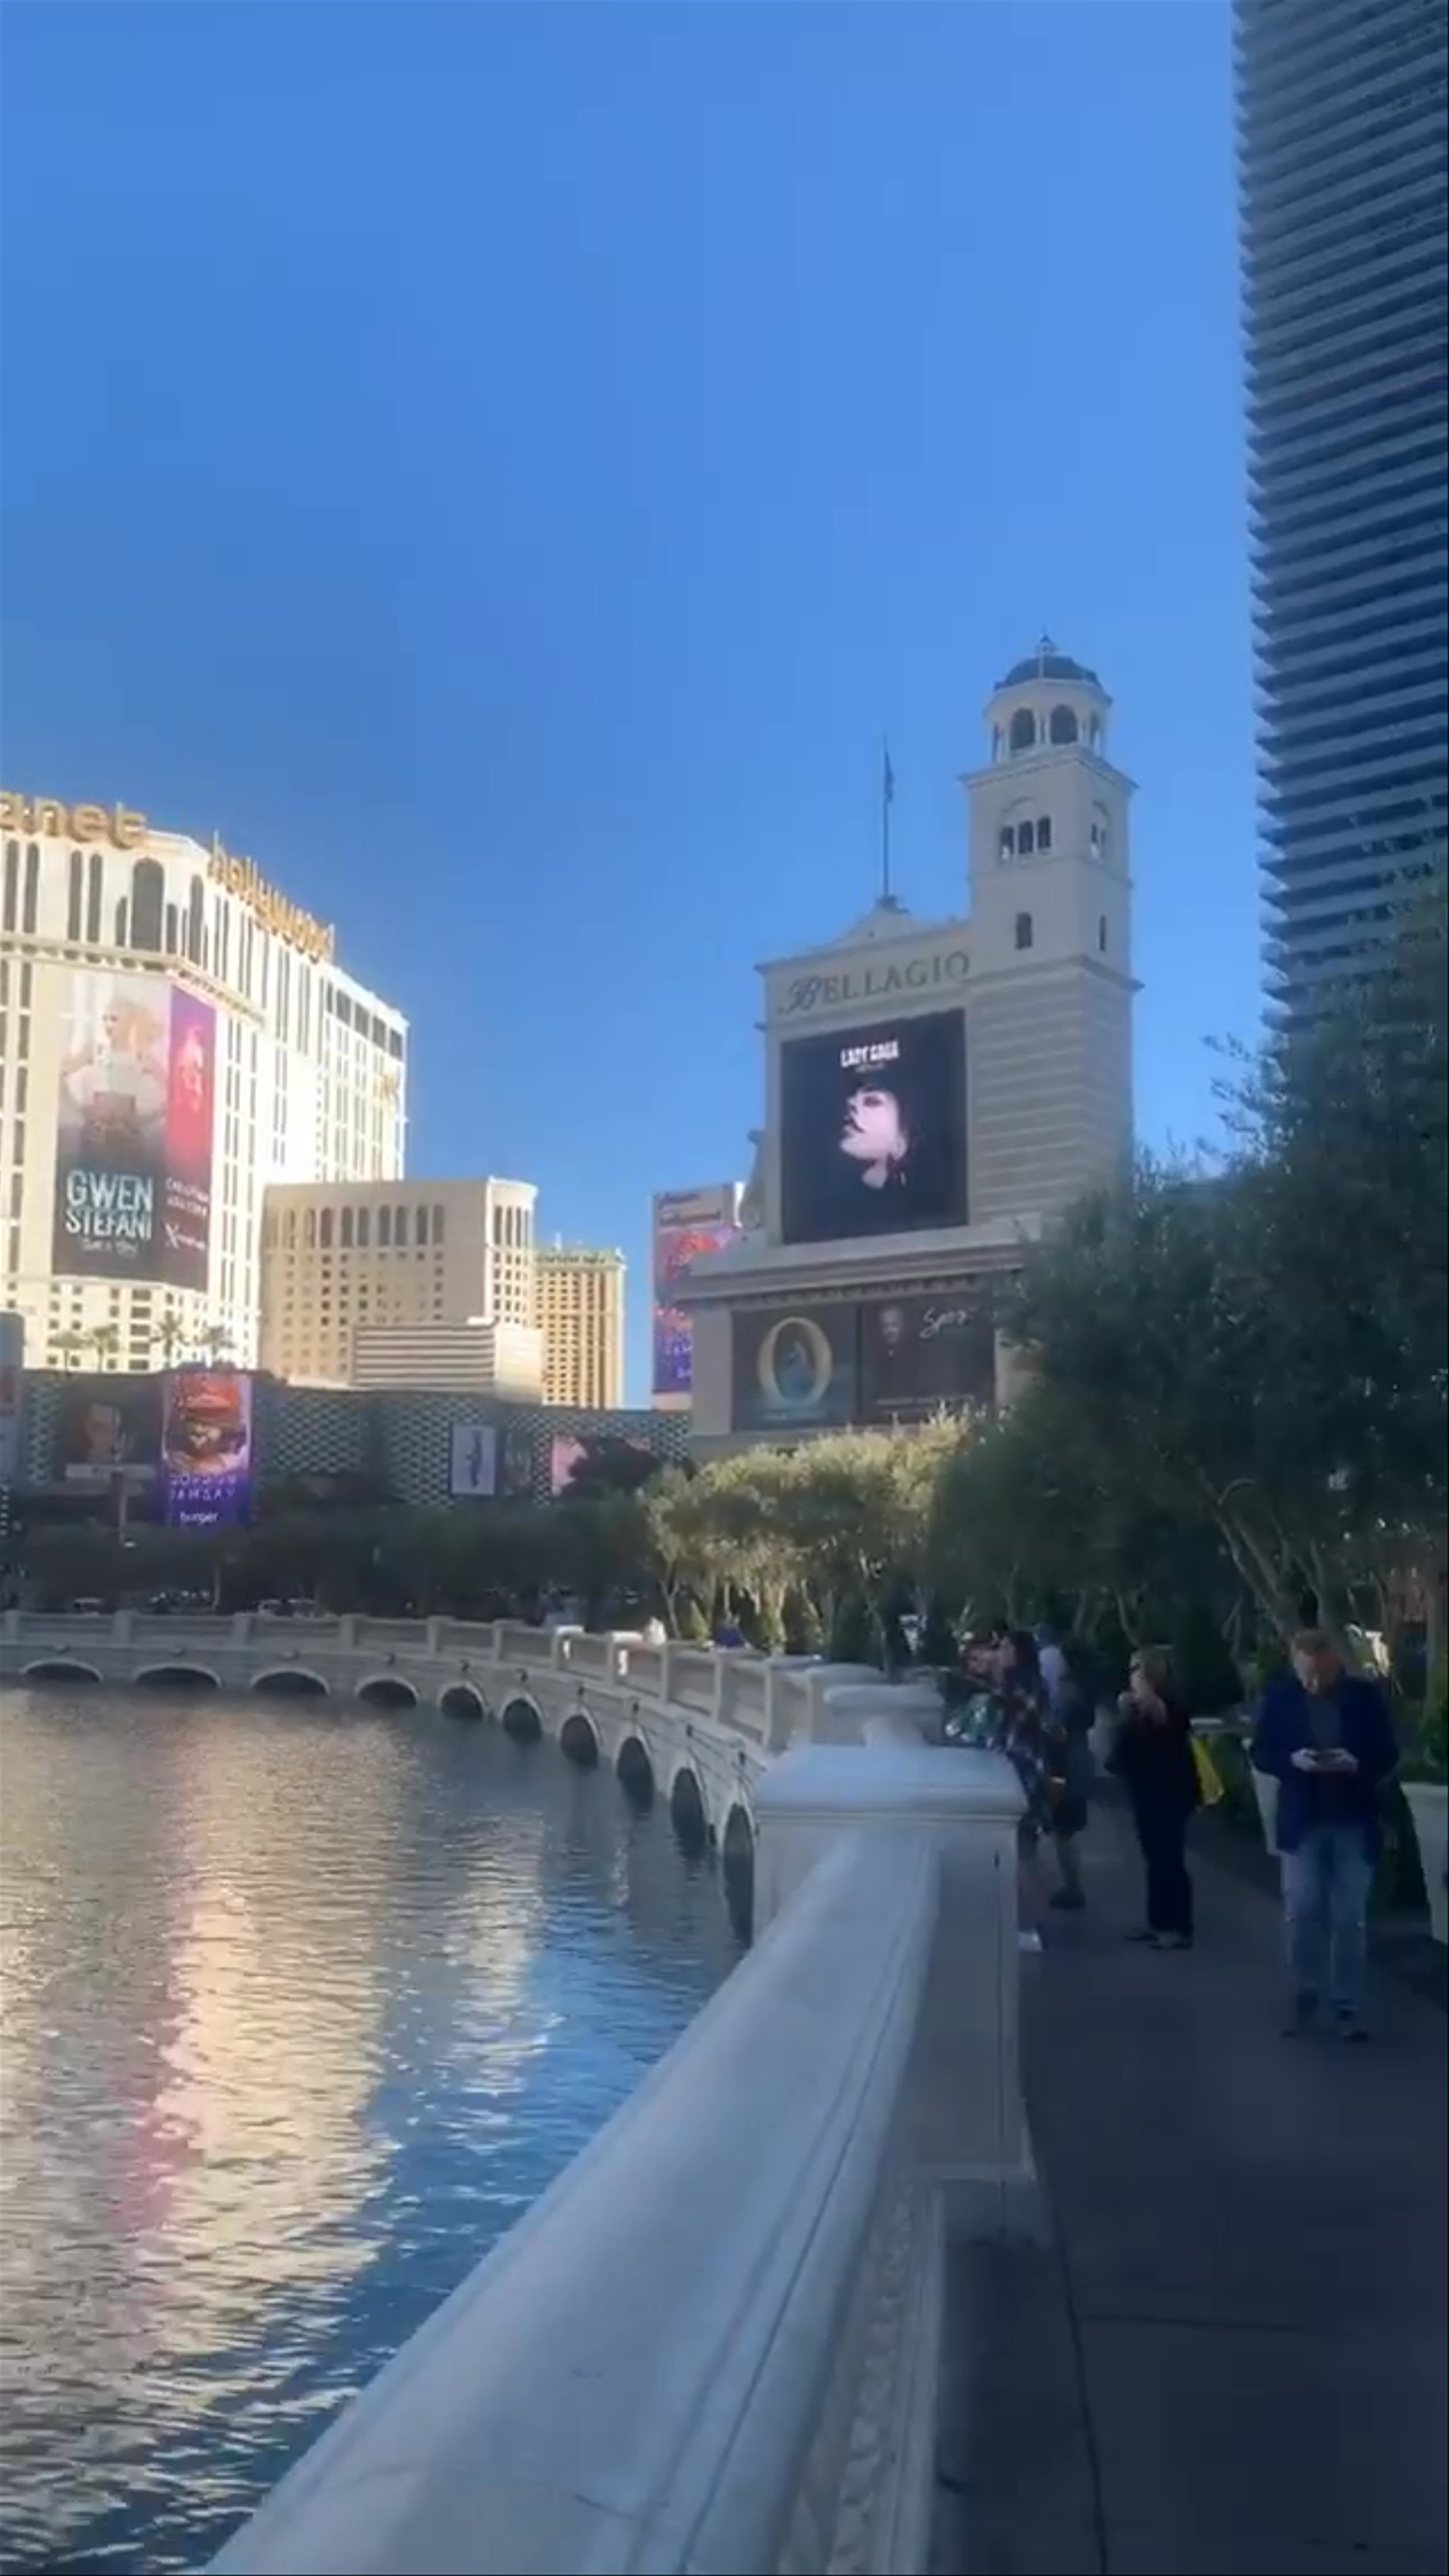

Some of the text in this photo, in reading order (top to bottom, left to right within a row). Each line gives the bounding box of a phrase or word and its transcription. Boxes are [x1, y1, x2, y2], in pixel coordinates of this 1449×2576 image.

[778, 951, 970, 1015] BELLAGIO
[841, 1046, 868, 1068] LADY
[67, 1170, 153, 1212] GWEN
[65, 1207, 152, 1240] STEFANI
